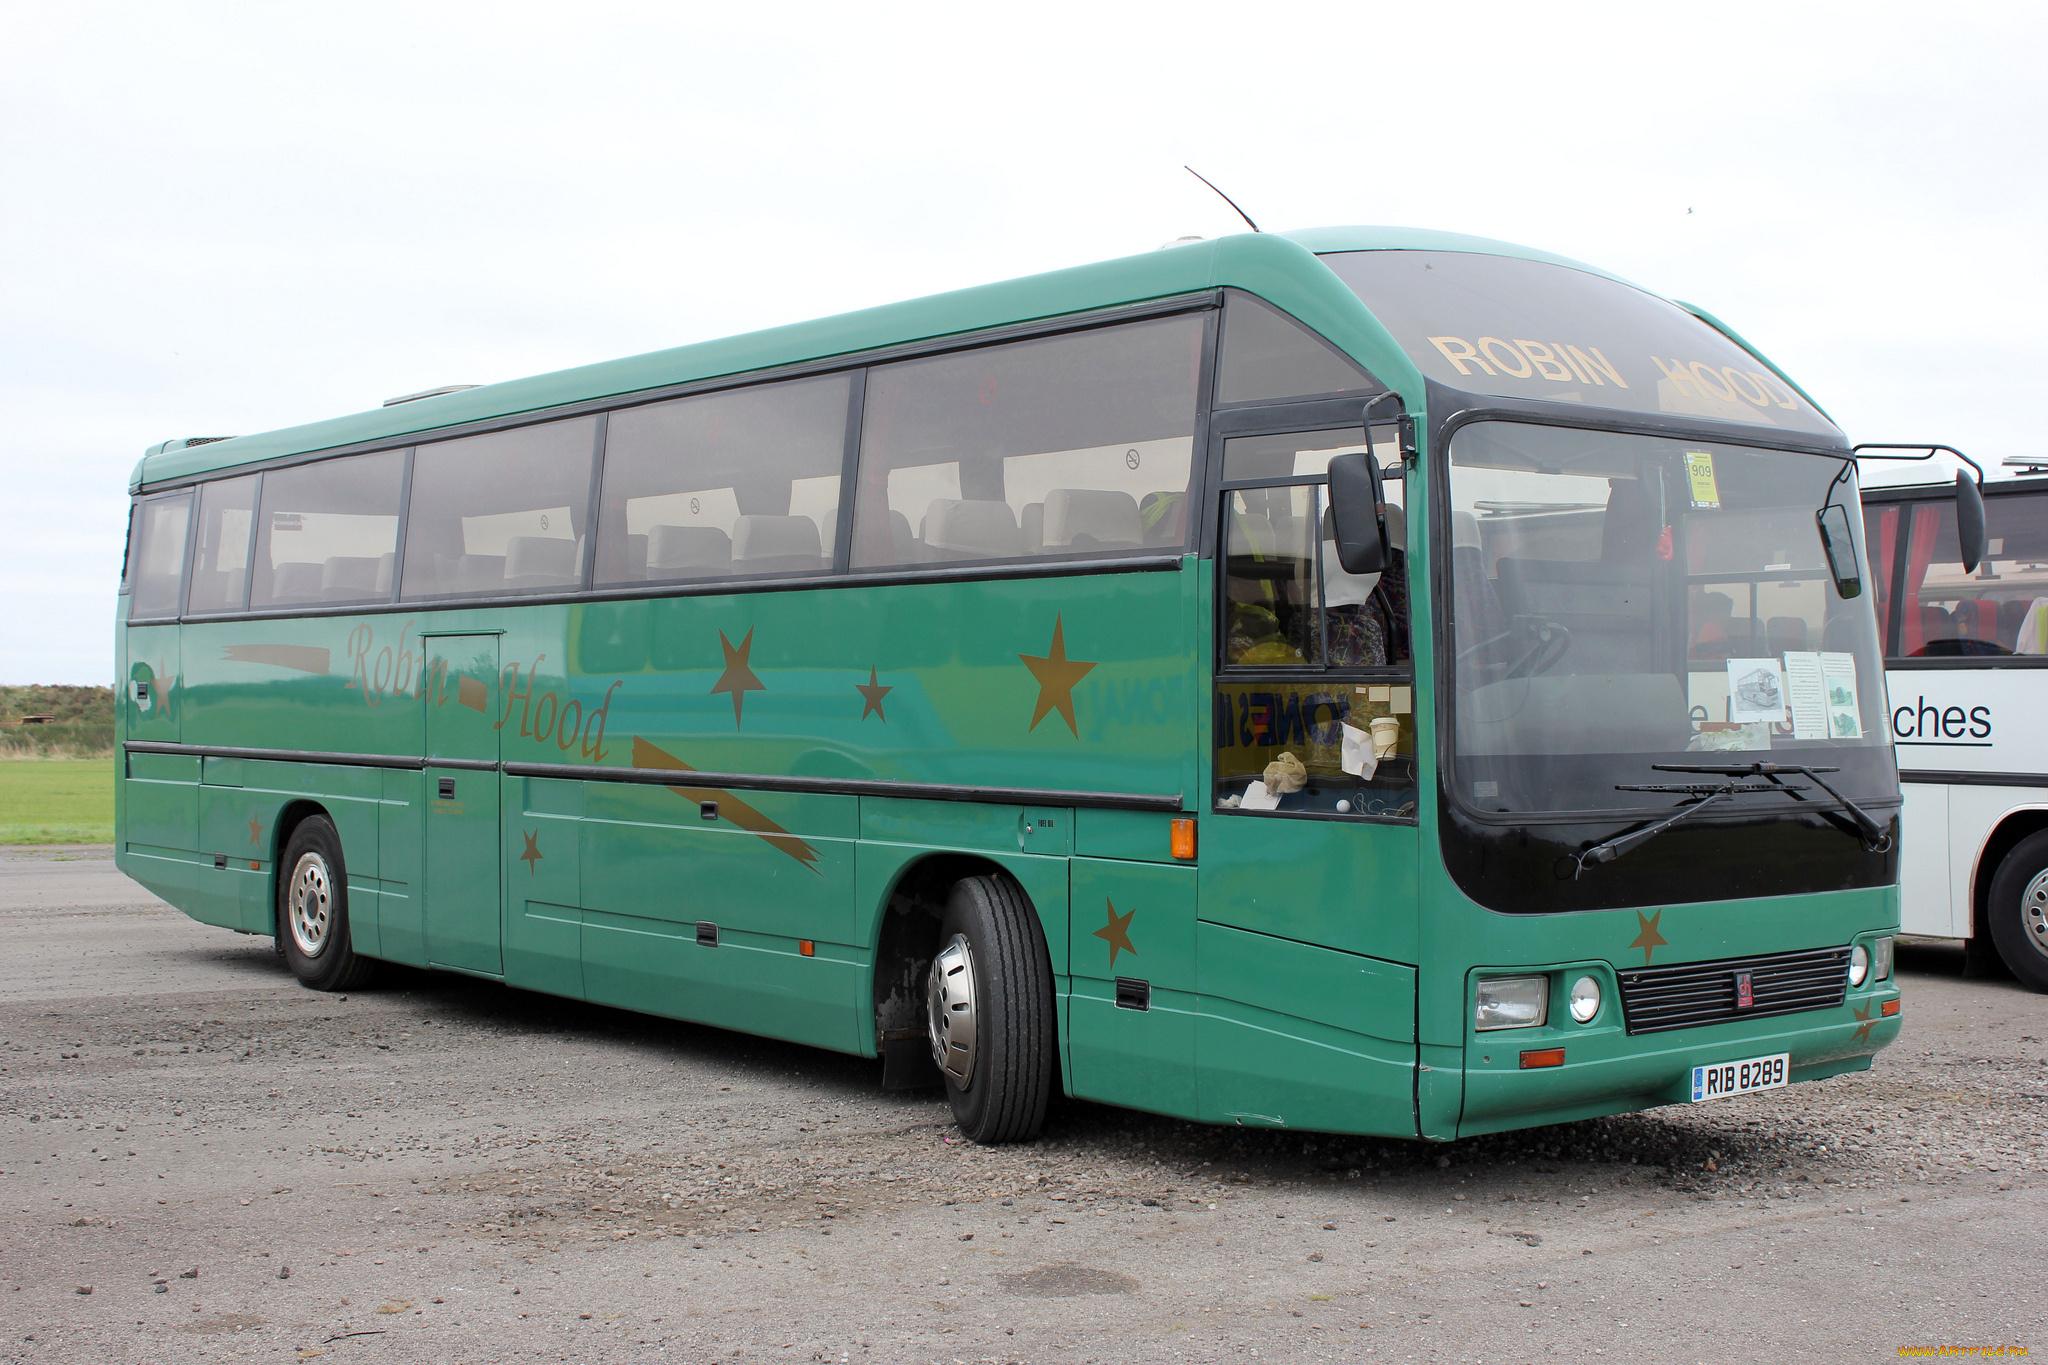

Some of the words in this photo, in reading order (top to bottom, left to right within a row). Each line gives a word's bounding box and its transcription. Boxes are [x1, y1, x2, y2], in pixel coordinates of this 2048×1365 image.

[1427, 336, 1629, 389] ROBIN
[1650, 356, 1798, 410] HOOD
[1691, 464, 1712, 477] 909
[344, 619, 449, 707] Robin
[493, 654, 623, 763] Hood
[1707, 1066, 1735, 1095] RIB
[1740, 1058, 1783, 1089] 8289
